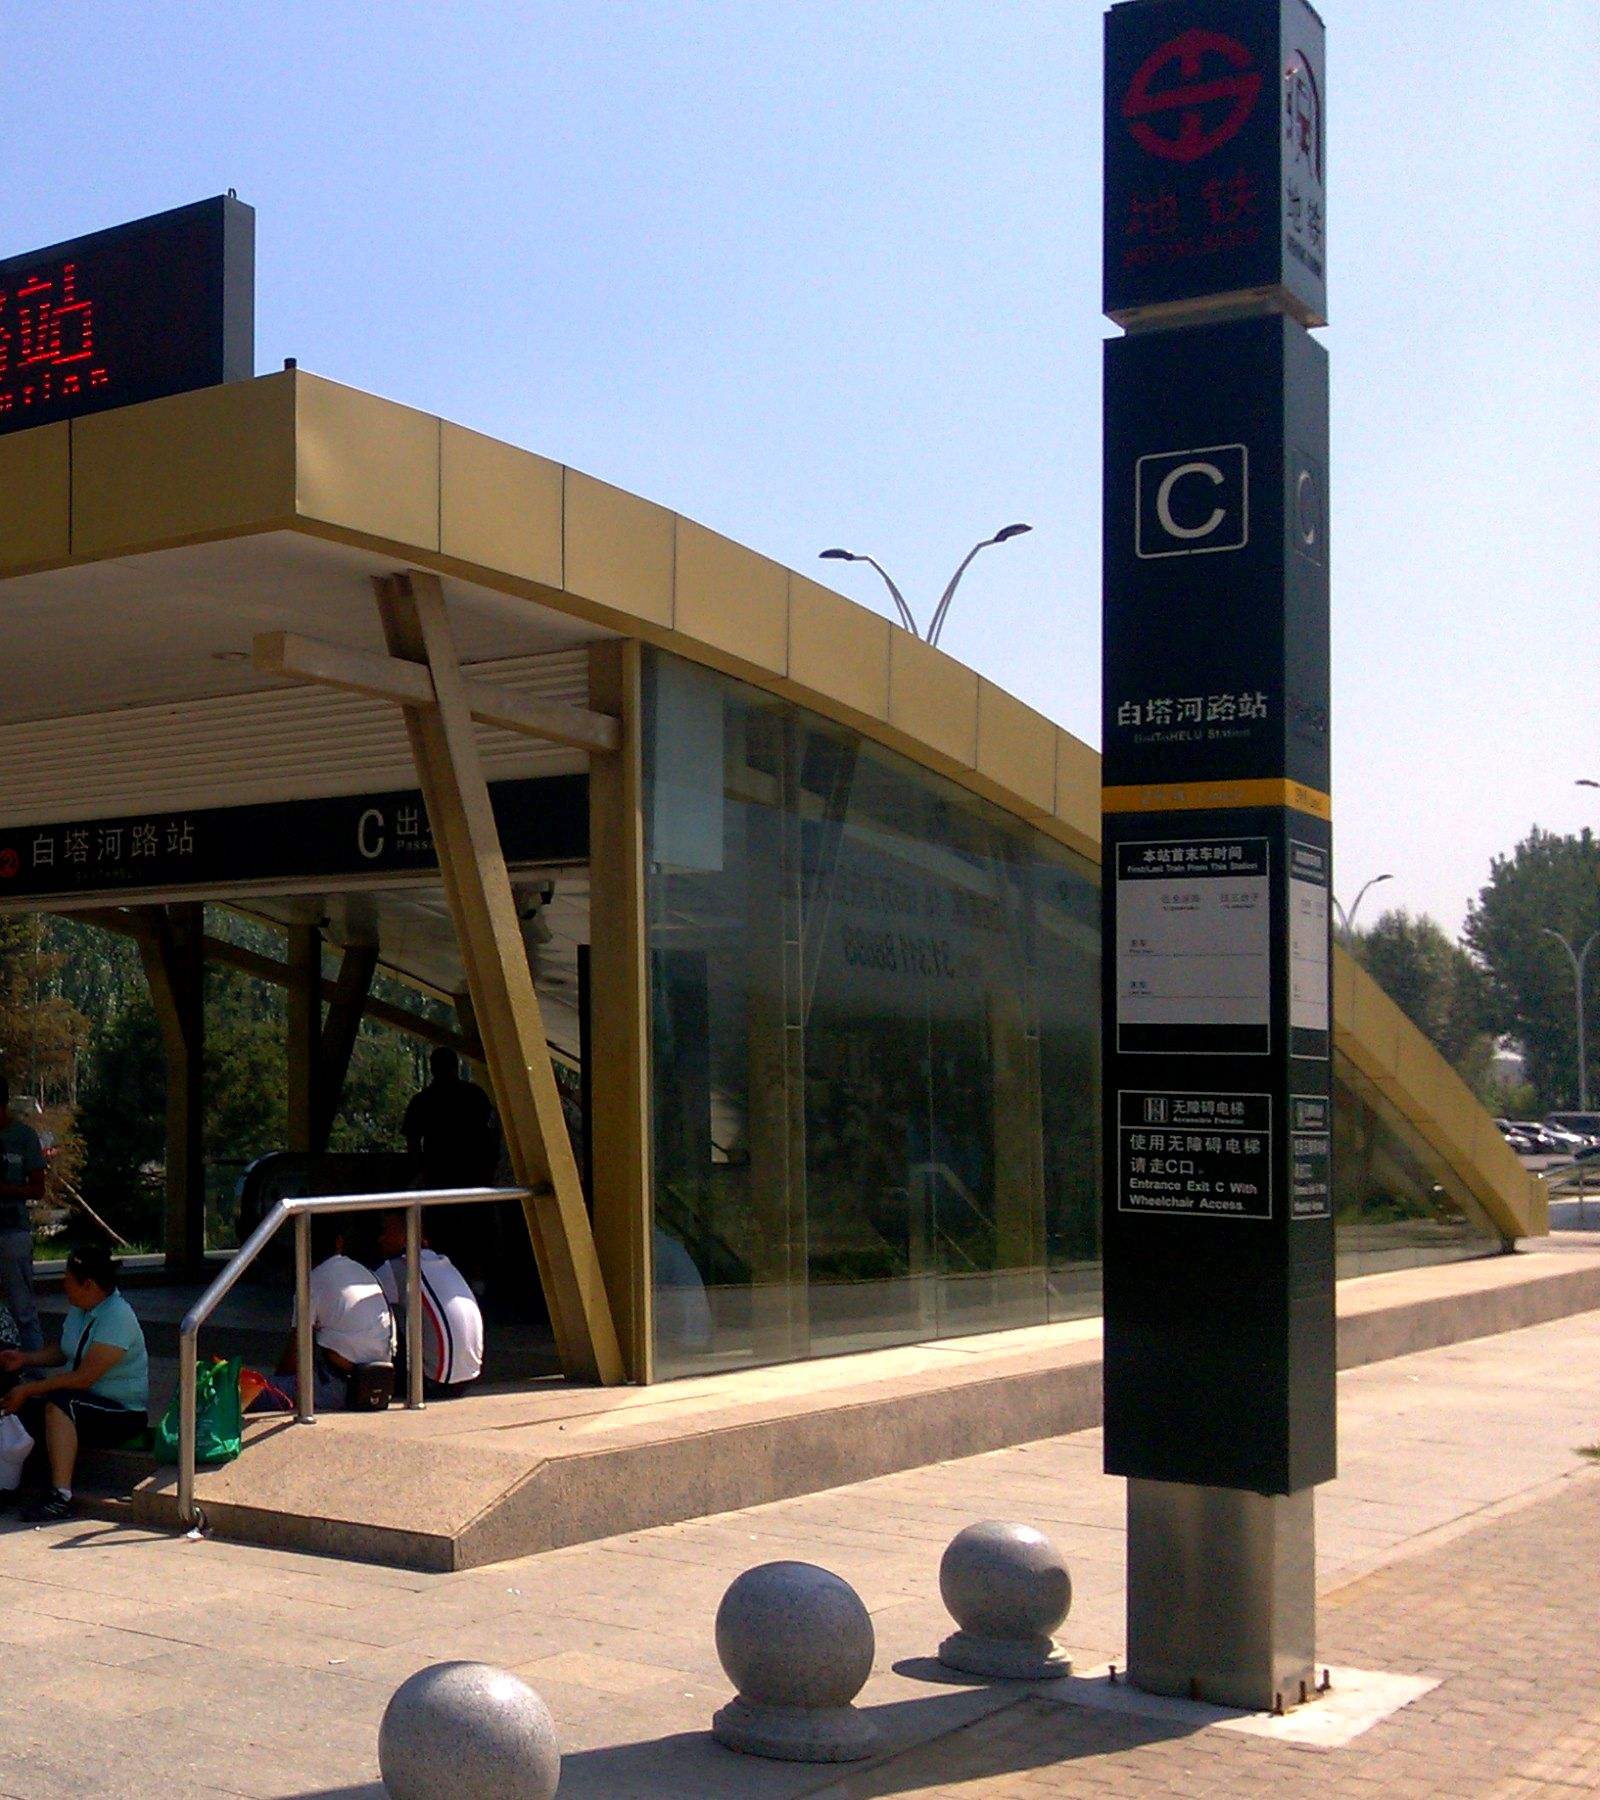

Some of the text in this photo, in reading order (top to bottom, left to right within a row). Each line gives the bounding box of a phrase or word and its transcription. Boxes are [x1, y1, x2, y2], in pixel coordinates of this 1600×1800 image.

[1157, 462, 1225, 538] C
[1117, 690, 1268, 726] 白塔河路站
[32, 819, 194, 867] 白塔河路站
[358, 808, 385, 859] C
[1173, 1100, 1246, 1116] 无障碍电梯
[1129, 1134, 1262, 1154] 使用无障碍电梯
[1129, 1178, 1259, 1195] Entrance Exit C With
[1129, 1194, 1194, 1208] Wheelchair
